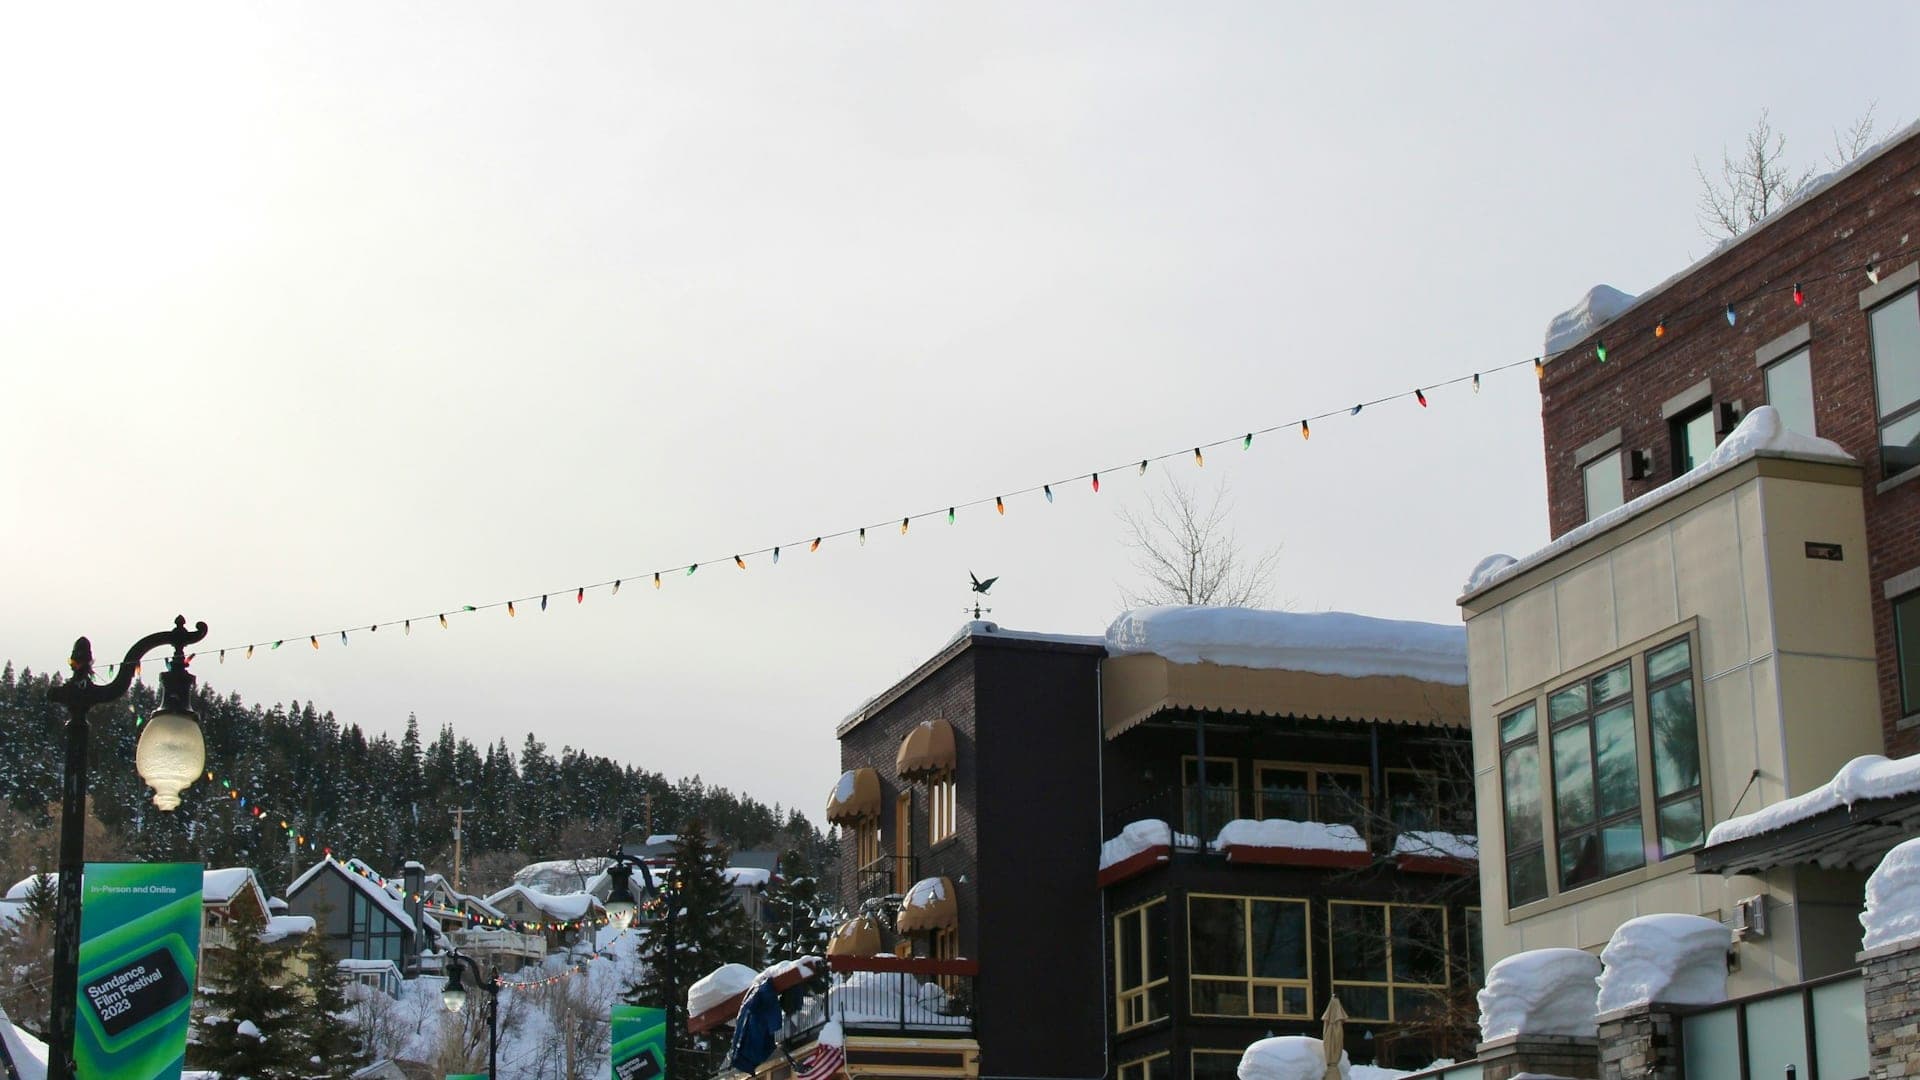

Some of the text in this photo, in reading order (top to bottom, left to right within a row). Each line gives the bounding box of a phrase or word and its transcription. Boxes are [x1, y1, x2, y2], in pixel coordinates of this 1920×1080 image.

[91, 885, 176, 894] In-Person and Online
[88, 966, 145, 998] Sundance
[94, 968, 163, 1010] Film Festival
[101, 999, 132, 1021] 2023
